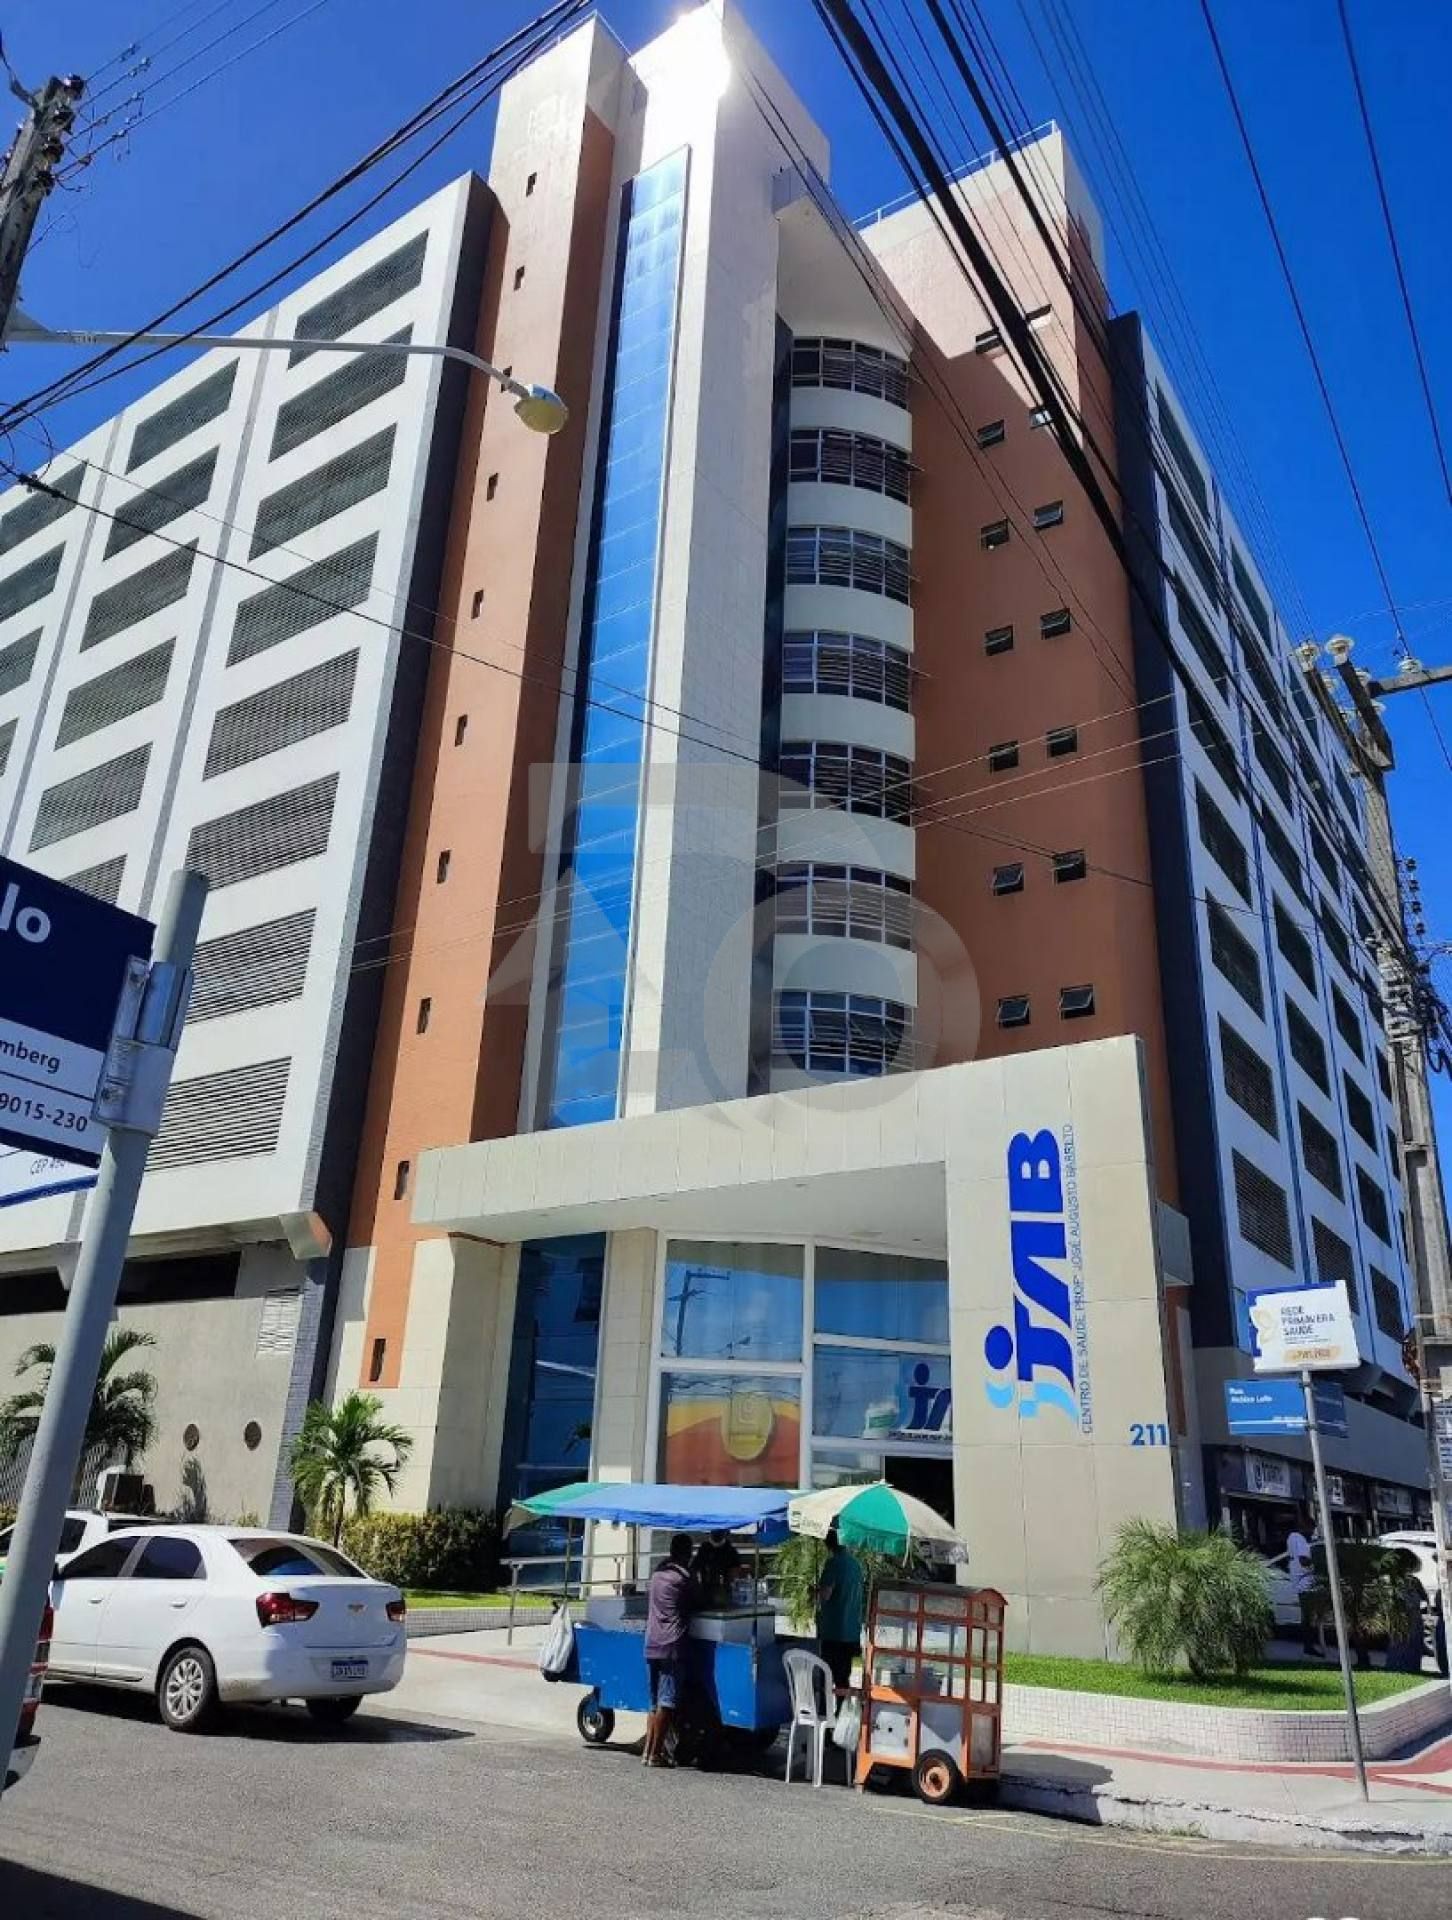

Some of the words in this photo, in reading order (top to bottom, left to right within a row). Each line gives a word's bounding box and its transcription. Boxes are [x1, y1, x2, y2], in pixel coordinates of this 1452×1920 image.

[1062, 1123, 1077, 1178] BARRETO
[1066, 1182, 1081, 1237] AUGUSTO
[1079, 1358, 1089, 1380] DE
[1079, 1382, 1093, 1434] CENTRO
[1129, 1423, 1168, 1446] 211
